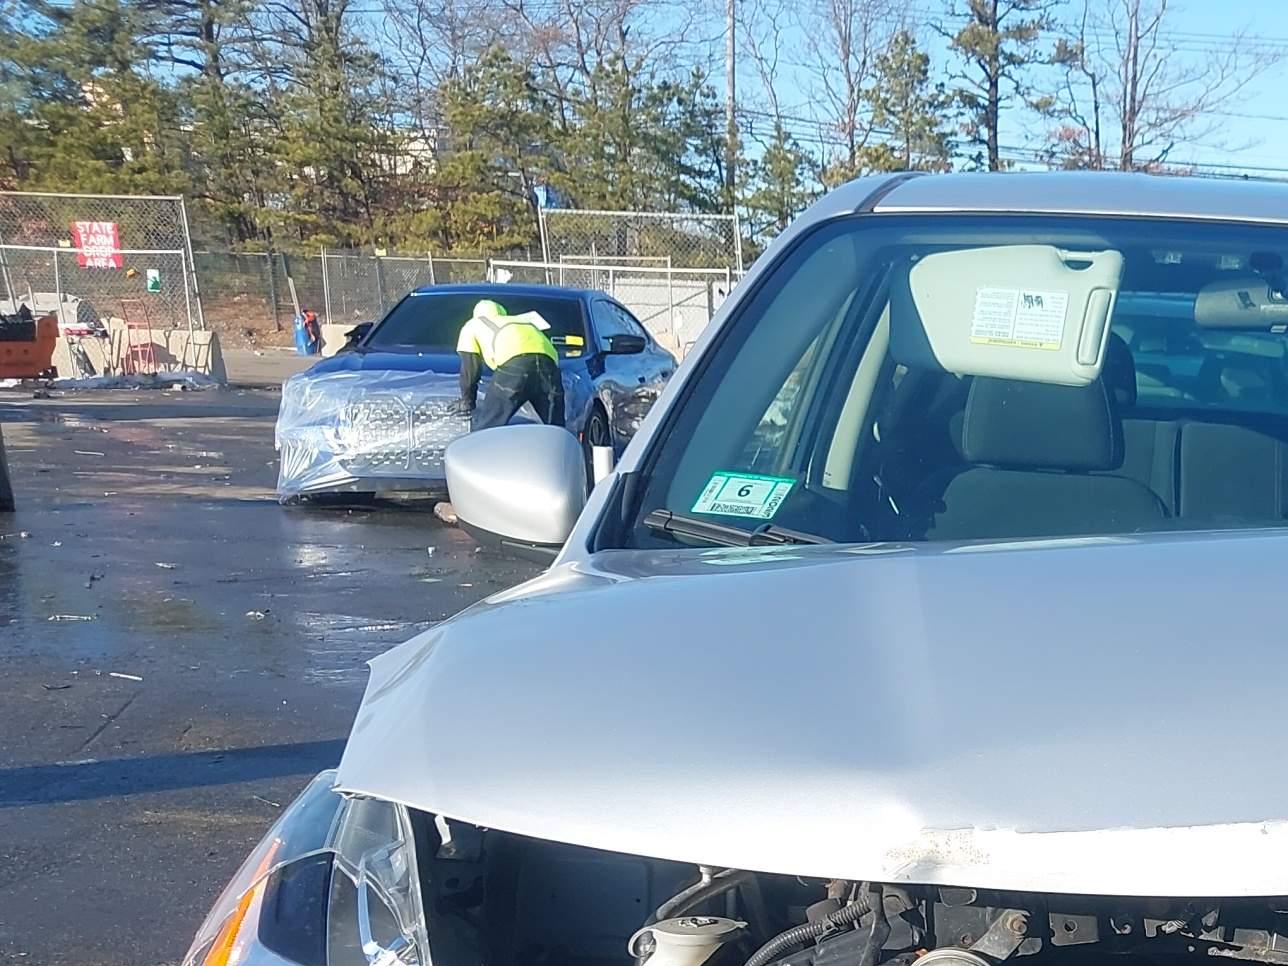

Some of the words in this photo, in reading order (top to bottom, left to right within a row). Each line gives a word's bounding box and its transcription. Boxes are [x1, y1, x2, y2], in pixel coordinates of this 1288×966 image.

[76, 222, 114, 234] STATE
[81, 233, 114, 246] FARM
[85, 256, 116, 269] AREA
[737, 484, 753, 497] 6
